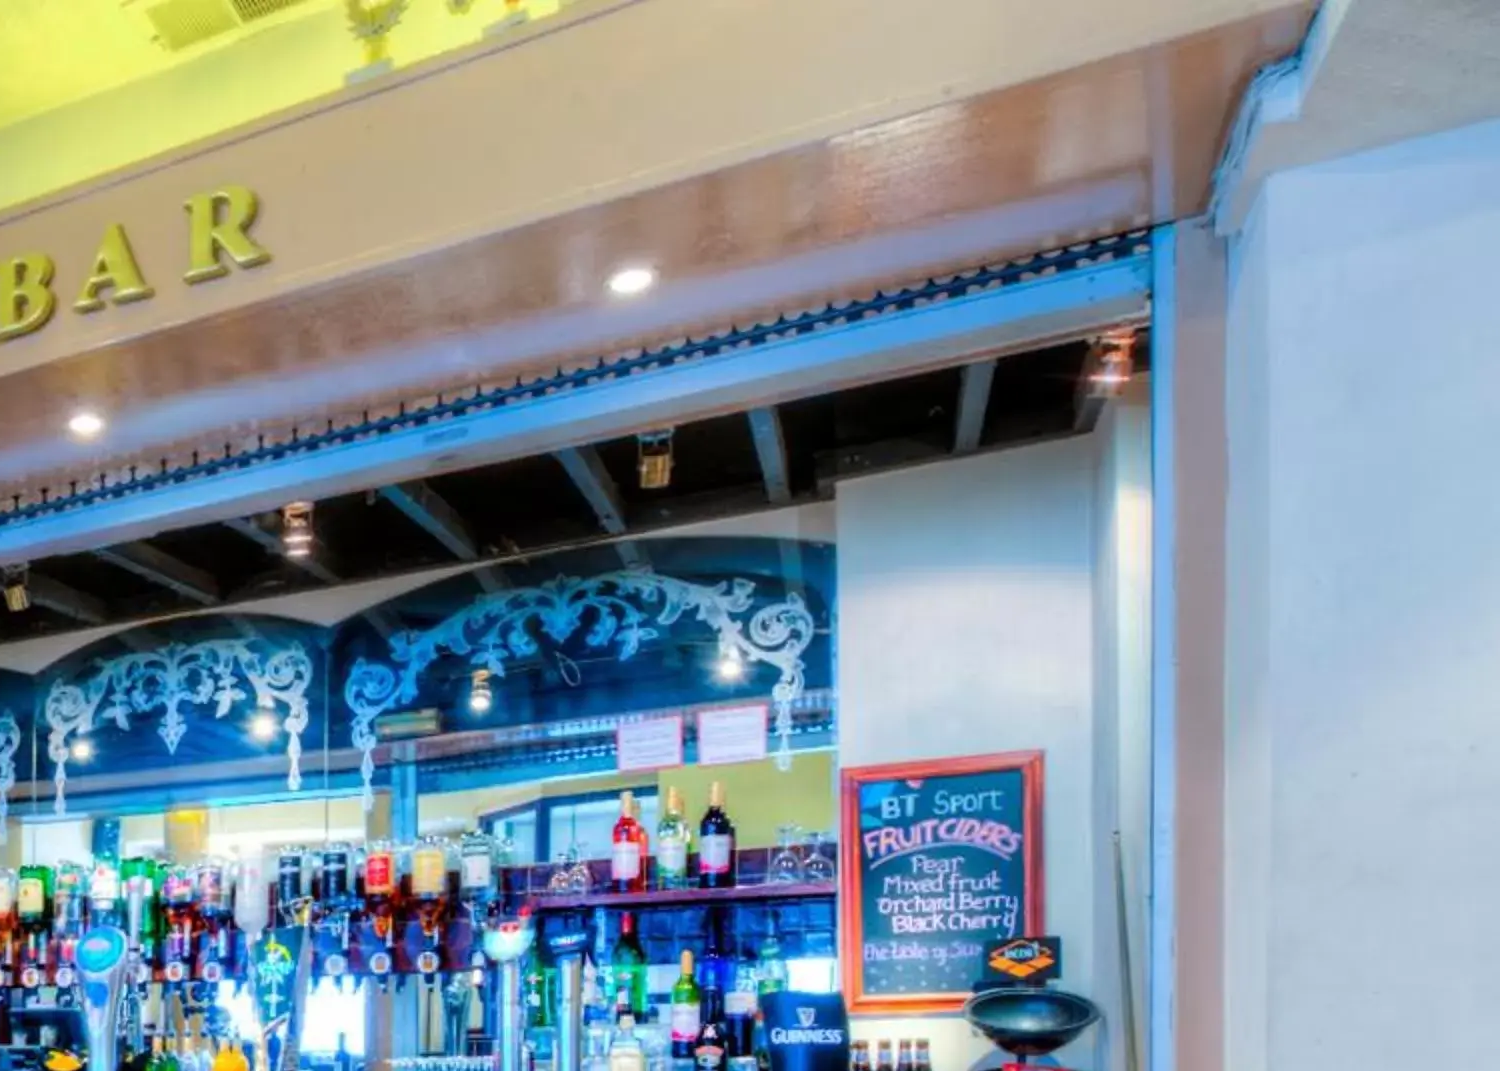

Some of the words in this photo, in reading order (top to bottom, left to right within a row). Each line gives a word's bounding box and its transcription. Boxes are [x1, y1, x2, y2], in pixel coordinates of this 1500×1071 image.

[881, 794, 919, 819] BT
[863, 819, 940, 858] FRUIT
[937, 817, 1023, 853] CIDERS
[911, 854, 965, 874] Pear
[883, 872, 945, 894] Mixed
[959, 891, 1018, 917] Berry
[892, 914, 946, 934] Black
[948, 912, 1018, 938] Cherry
[771, 1028, 843, 1044] GUINNESS
